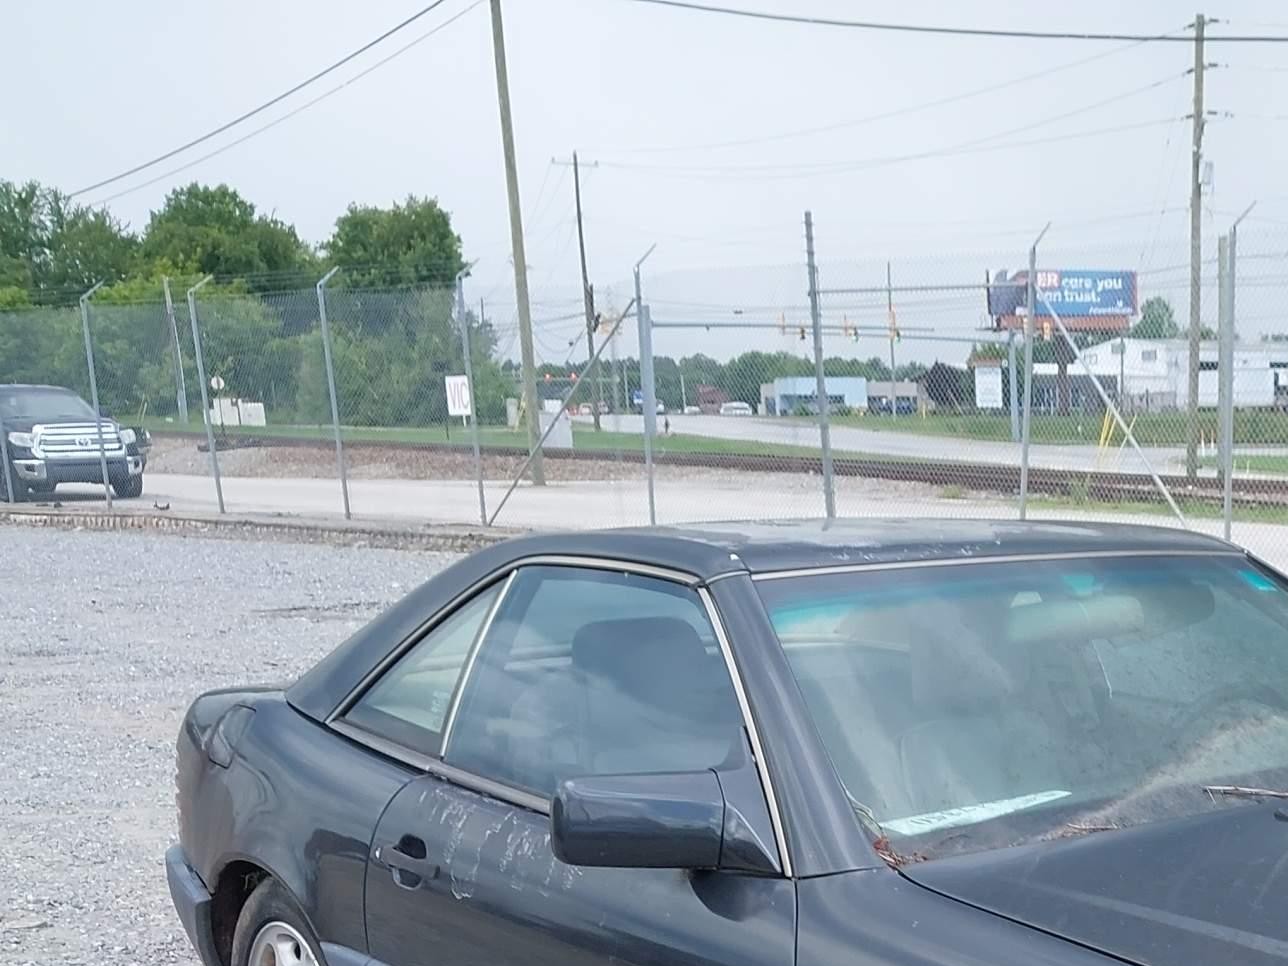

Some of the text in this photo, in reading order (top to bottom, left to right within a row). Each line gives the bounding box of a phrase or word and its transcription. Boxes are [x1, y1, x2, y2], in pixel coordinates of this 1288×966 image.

[1061, 278, 1092, 289] care
[1096, 278, 1123, 292] you
[1064, 289, 1101, 302] trust.
